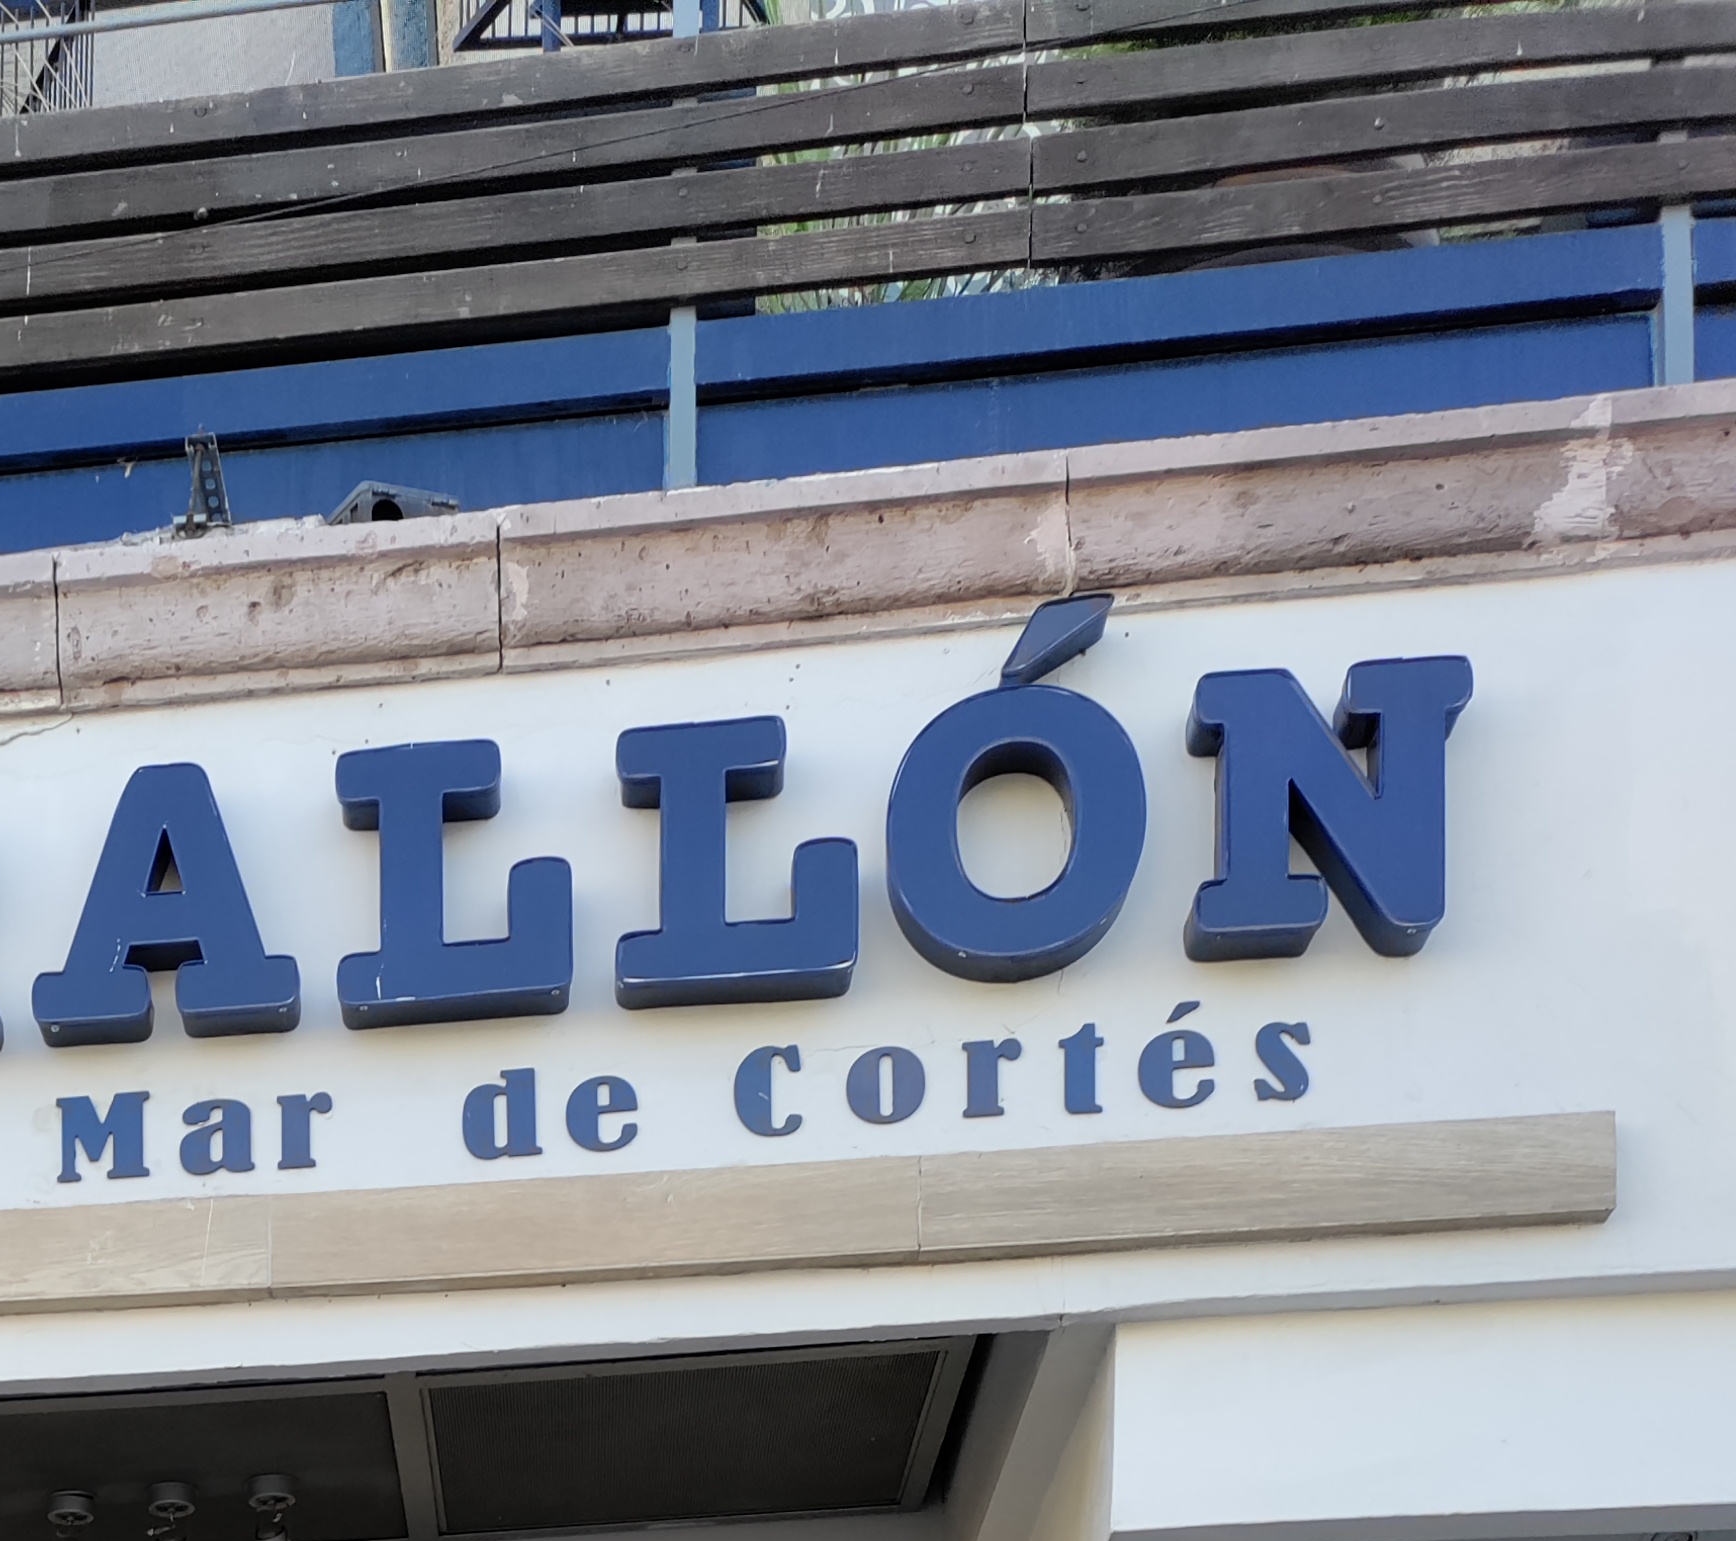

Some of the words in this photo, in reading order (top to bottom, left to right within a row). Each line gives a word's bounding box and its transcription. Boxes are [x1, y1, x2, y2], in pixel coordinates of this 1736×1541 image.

[56, 1089, 333, 1184] Mar
[464, 1067, 640, 1161] de
[733, 1001, 1314, 1137] Cortés
